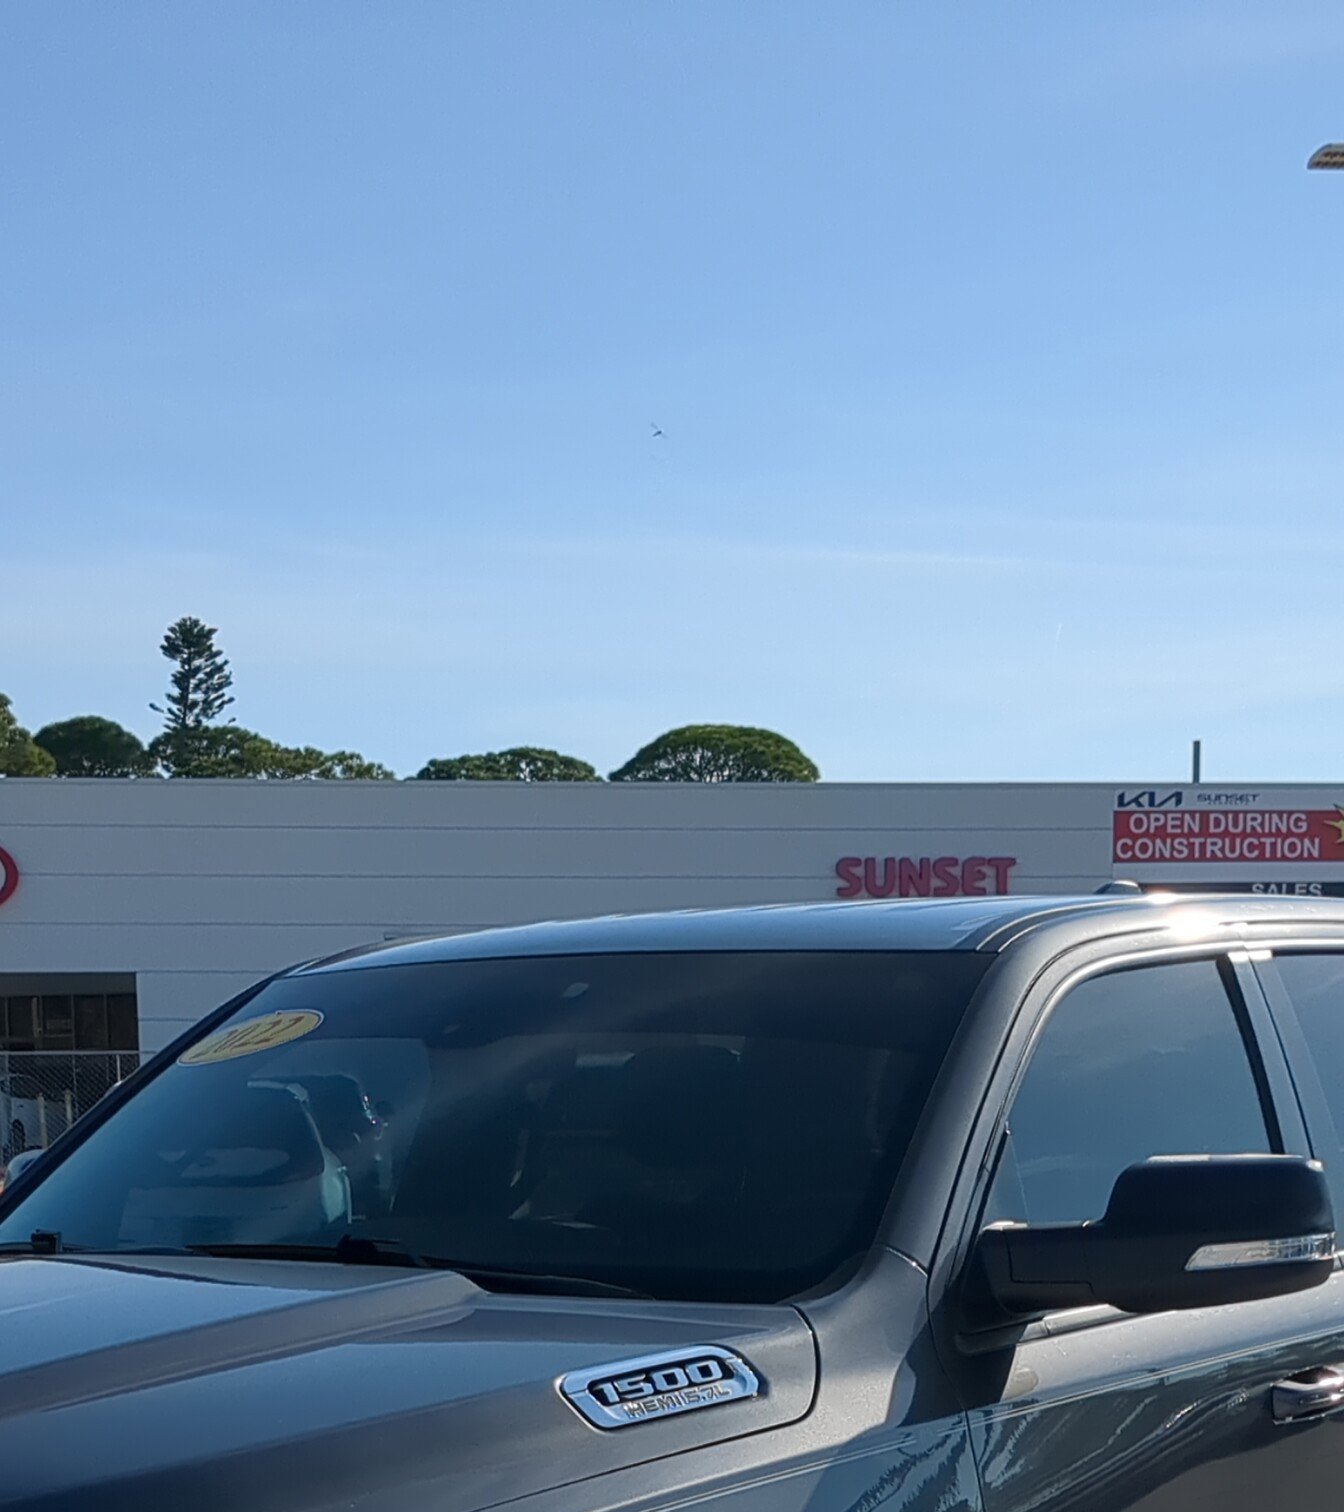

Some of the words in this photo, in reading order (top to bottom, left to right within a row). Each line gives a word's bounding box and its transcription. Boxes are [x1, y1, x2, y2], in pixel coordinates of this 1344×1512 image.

[1116, 790, 1184, 809] KIA
[1128, 812, 1201, 835] OPEN
[1208, 812, 1309, 834] DURING
[1115, 836, 1321, 860] CONSTRUCTION
[834, 856, 1018, 898] SUNSET
[188, 1014, 305, 1060] 2022
[593, 1360, 723, 1404] 1500
[622, 1390, 686, 1419] HEMI
